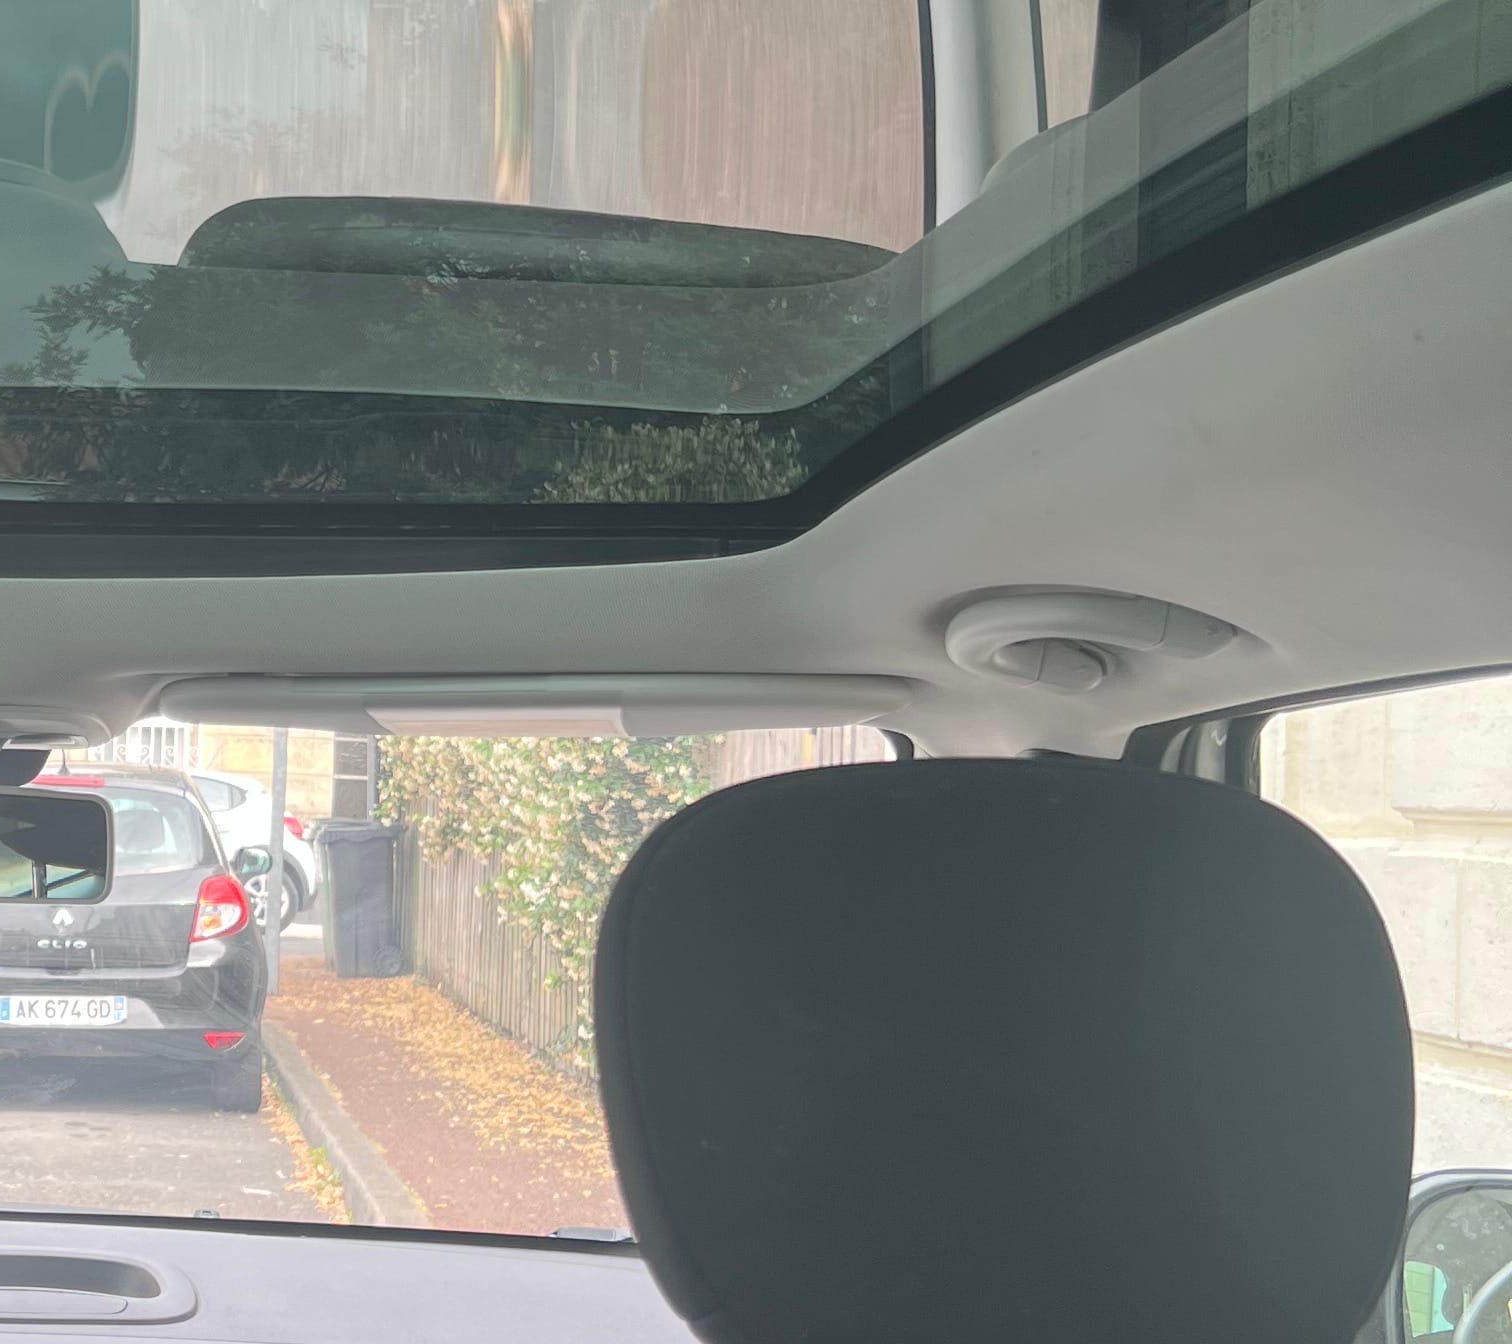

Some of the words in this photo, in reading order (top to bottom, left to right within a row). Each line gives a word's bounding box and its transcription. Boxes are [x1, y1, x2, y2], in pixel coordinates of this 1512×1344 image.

[37, 938, 88, 949] CLIO
[16, 999, 39, 1018] AK
[45, 999, 81, 1018] 674
[87, 999, 111, 1018] GD
